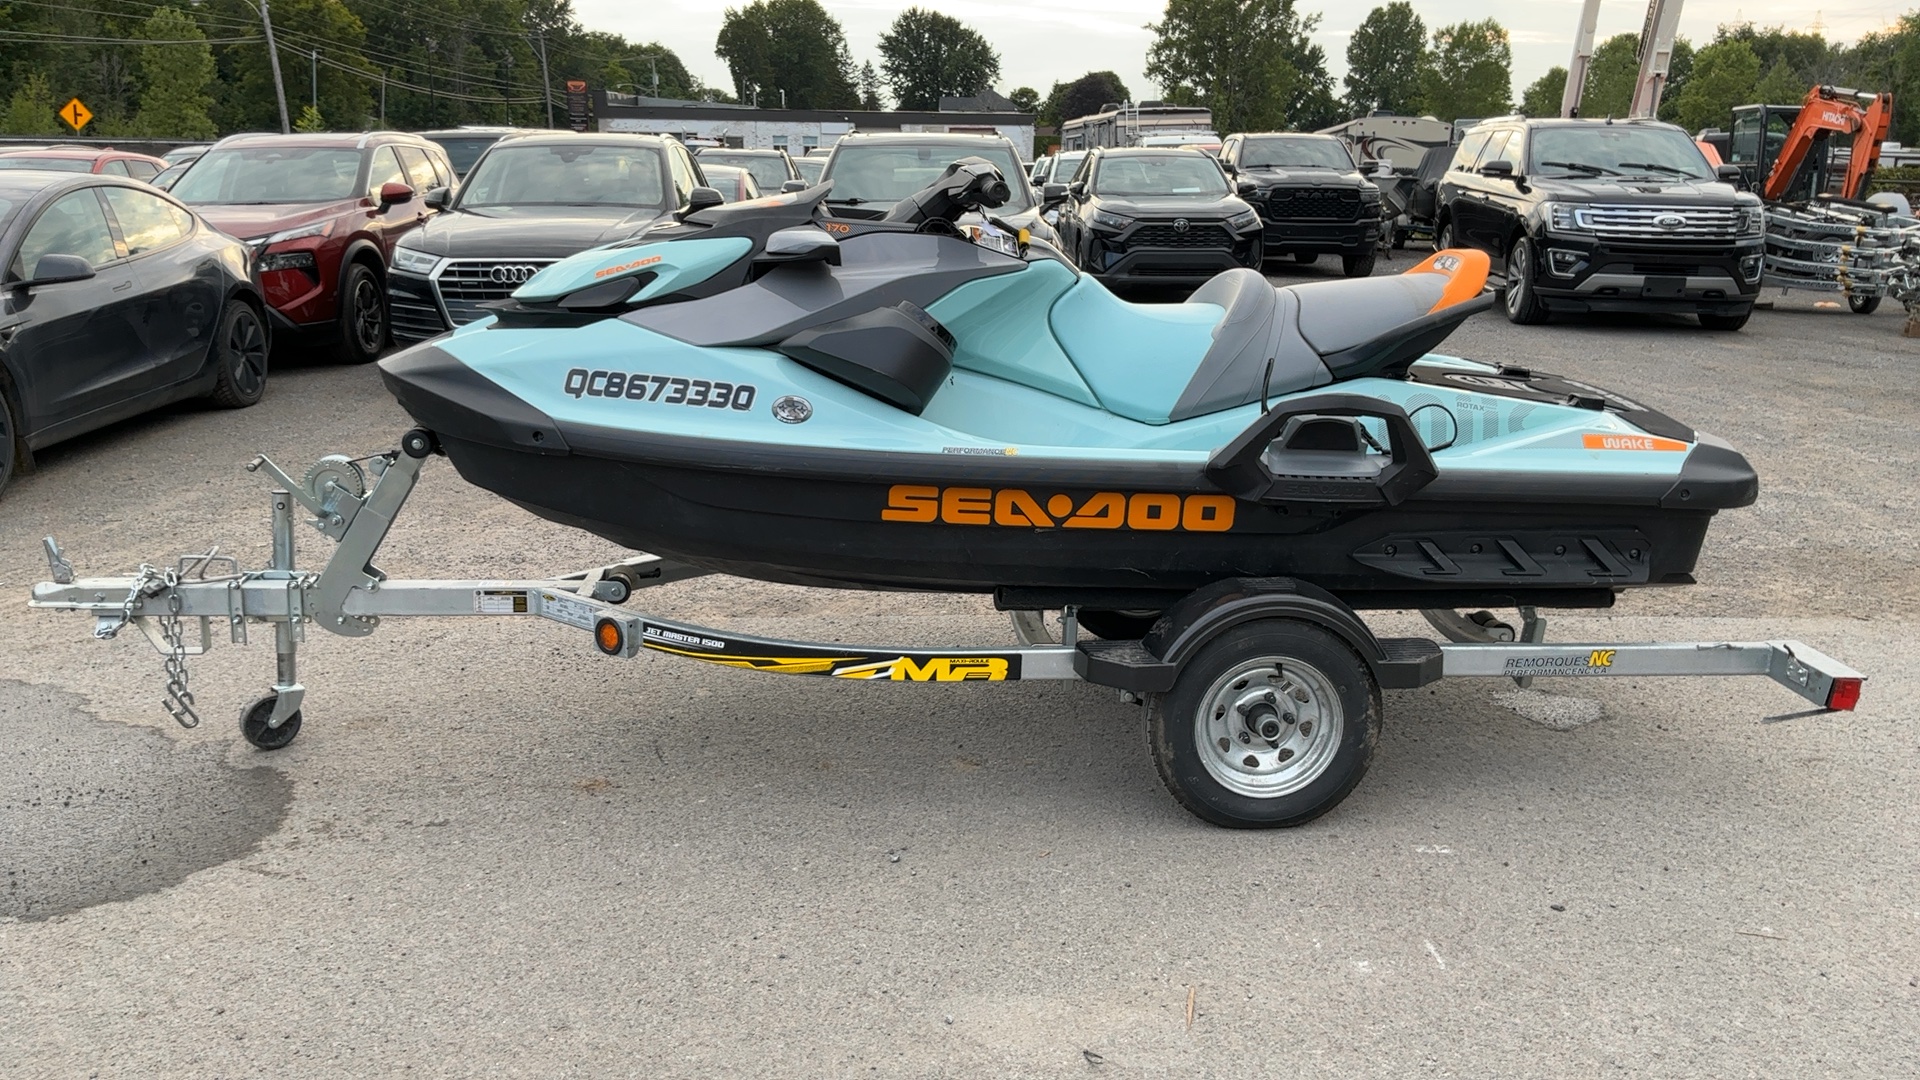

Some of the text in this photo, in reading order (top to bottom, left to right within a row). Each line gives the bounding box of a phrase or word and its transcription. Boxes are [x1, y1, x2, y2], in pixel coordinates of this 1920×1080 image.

[825, 223, 849, 233] 170
[564, 368, 757, 412] QC8673330
[1456, 401, 1485, 411] ROTAX
[1602, 437, 1654, 450] WAKE
[646, 626, 725, 649] JET MASTER 1500
